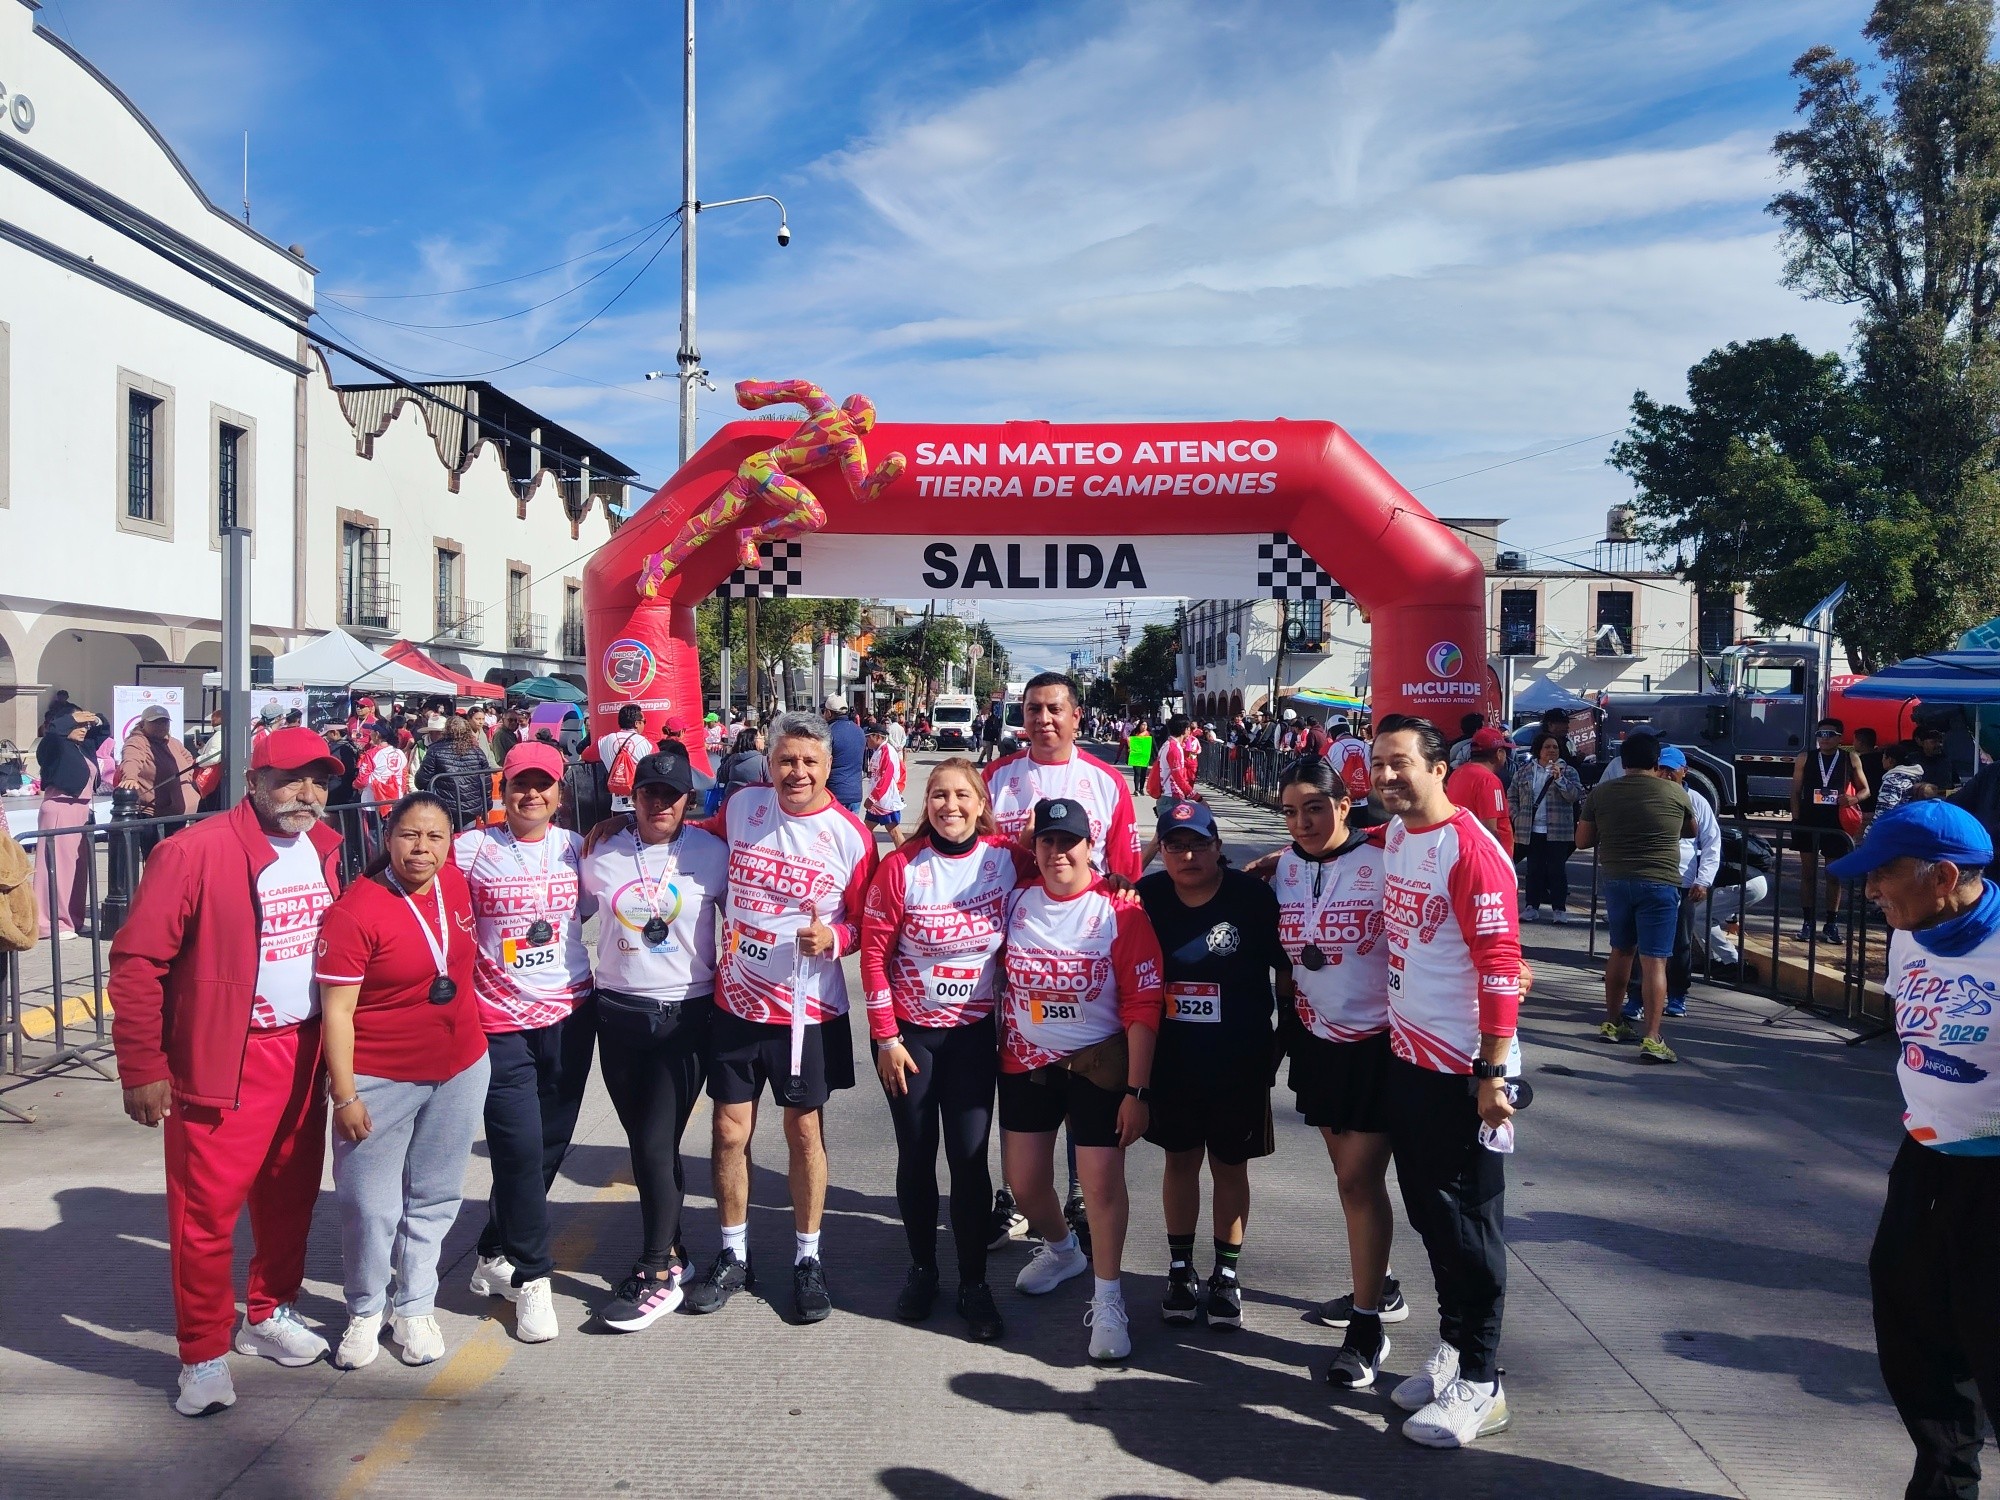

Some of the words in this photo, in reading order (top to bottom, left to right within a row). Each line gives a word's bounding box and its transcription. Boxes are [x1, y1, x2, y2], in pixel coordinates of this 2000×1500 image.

[915, 442, 987, 466] SAN
[998, 442, 1123, 465] MATEO
[1132, 439, 1278, 464] ATENCO
[915, 476, 1024, 498] TIERRA
[1032, 475, 1076, 497] DE
[1082, 471, 1278, 497] CAMPEONES
[921, 542, 1147, 590] SALIDA
[1402, 682, 1481, 696] IMCUFIDE
[599, 701, 669, 713] #Unidiempre
[1573, 730, 1597, 743] RSA
[733, 840, 750, 850] GRAN
[750, 844, 785, 858] CARRERA
[785, 852, 826, 869] ATLÉTICA
[733, 852, 777, 875] TIERRA
[780, 864, 810, 882] DEL
[550, 872, 578, 880] ATLÉTIC
[729, 865, 807, 898] CALZADO
[268, 884, 310, 897] CARRERA
[485, 884, 547, 899] TIERR
[551, 882, 577, 895] DEL
[740, 888, 761, 898] MATEO
[761, 893, 789, 904] ATENCO
[930, 901, 967, 911] CARRERA
[968, 886, 1003, 906] ATLÉTICA
[262, 897, 309, 918] IERRA
[1329, 898, 1374, 909] ATLÉTICA
[1399, 891, 1419, 909] DEL
[1473, 891, 1504, 908] 10K
[261, 910, 324, 934] ALZAD
[912, 912, 967, 929] TIERRA
[969, 904, 998, 920] DEL
[1325, 912, 1360, 924] DEL
[1475, 907, 1505, 923] /5K
[905, 915, 1001, 944] CALZADO
[1278, 925, 1361, 942] ALZADO
[276, 935, 301, 946] MATEO
[914, 944, 929, 952] SAN
[930, 944, 958, 952] MATEO
[960, 937, 991, 948] ATENCO
[274, 946, 300, 960] 10K
[512, 949, 555, 969] 0525
[1057, 961, 1087, 974] DEL
[1135, 957, 1155, 975] 10K
[1006, 967, 1088, 991] ALZADO
[1137, 970, 1160, 988] /5K
[1387, 971, 1401, 991] 28
[1482, 974, 1510, 986] 10K
[1897, 968, 1955, 1004] ETEPE
[936, 982, 974, 997] 0001
[1938, 1024, 1990, 1042] 2026
[1924, 1060, 1960, 1077] ANFORA
